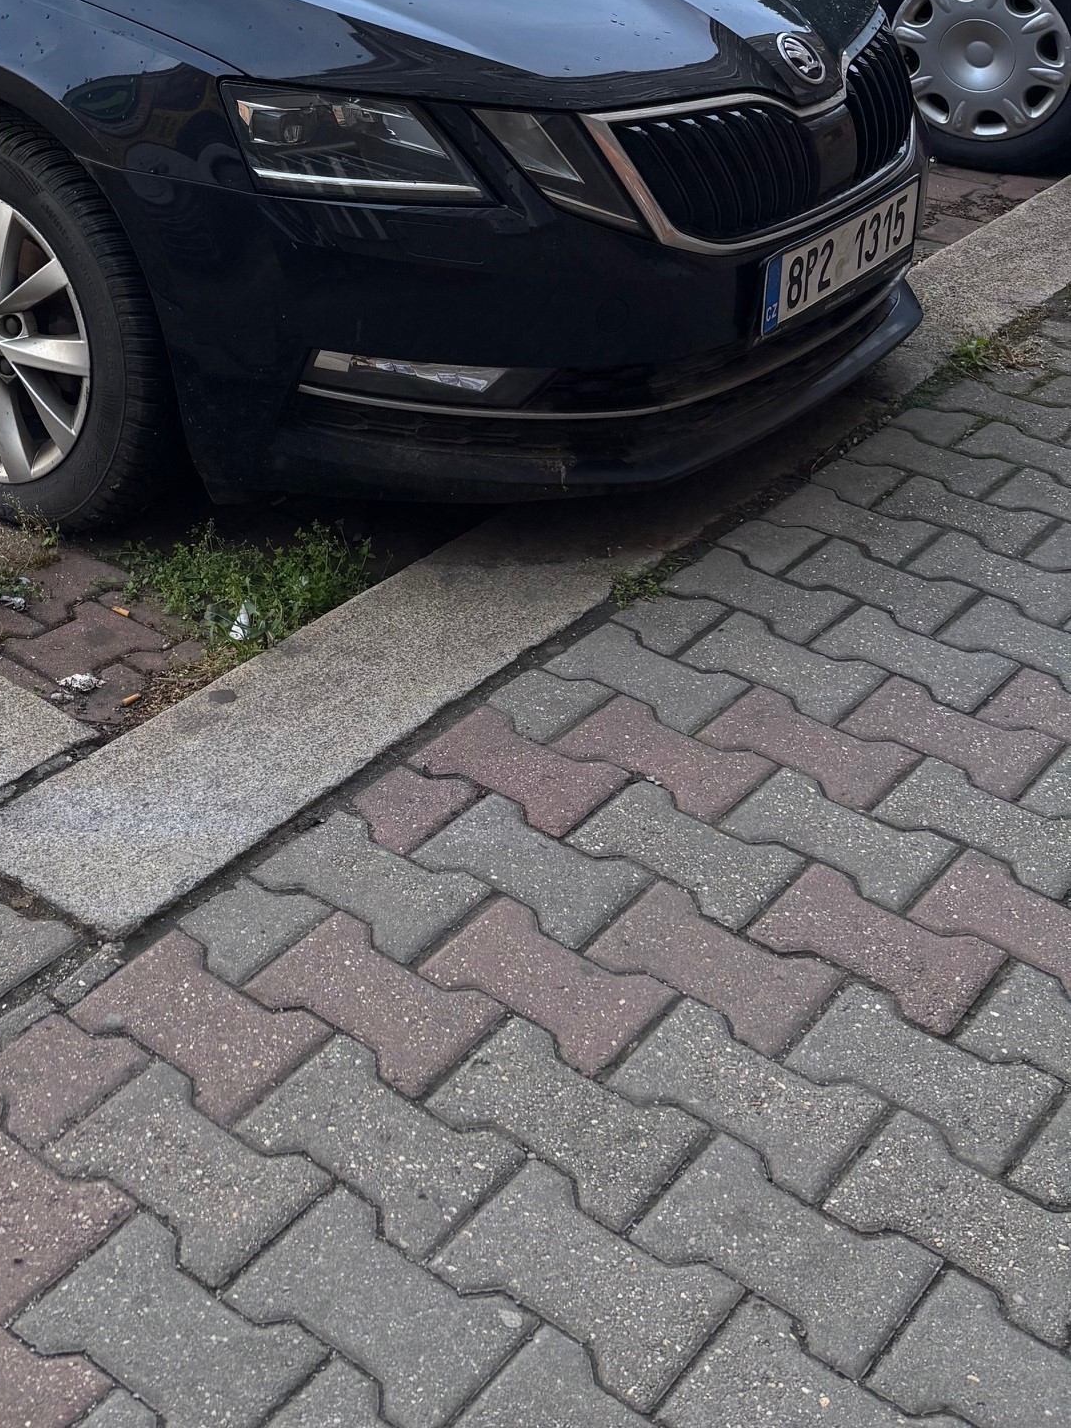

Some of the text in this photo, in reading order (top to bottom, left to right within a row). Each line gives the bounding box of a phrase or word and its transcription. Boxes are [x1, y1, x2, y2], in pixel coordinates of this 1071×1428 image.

[786, 195, 908, 310] 8P2 1315
[765, 302, 777, 322] CZ
